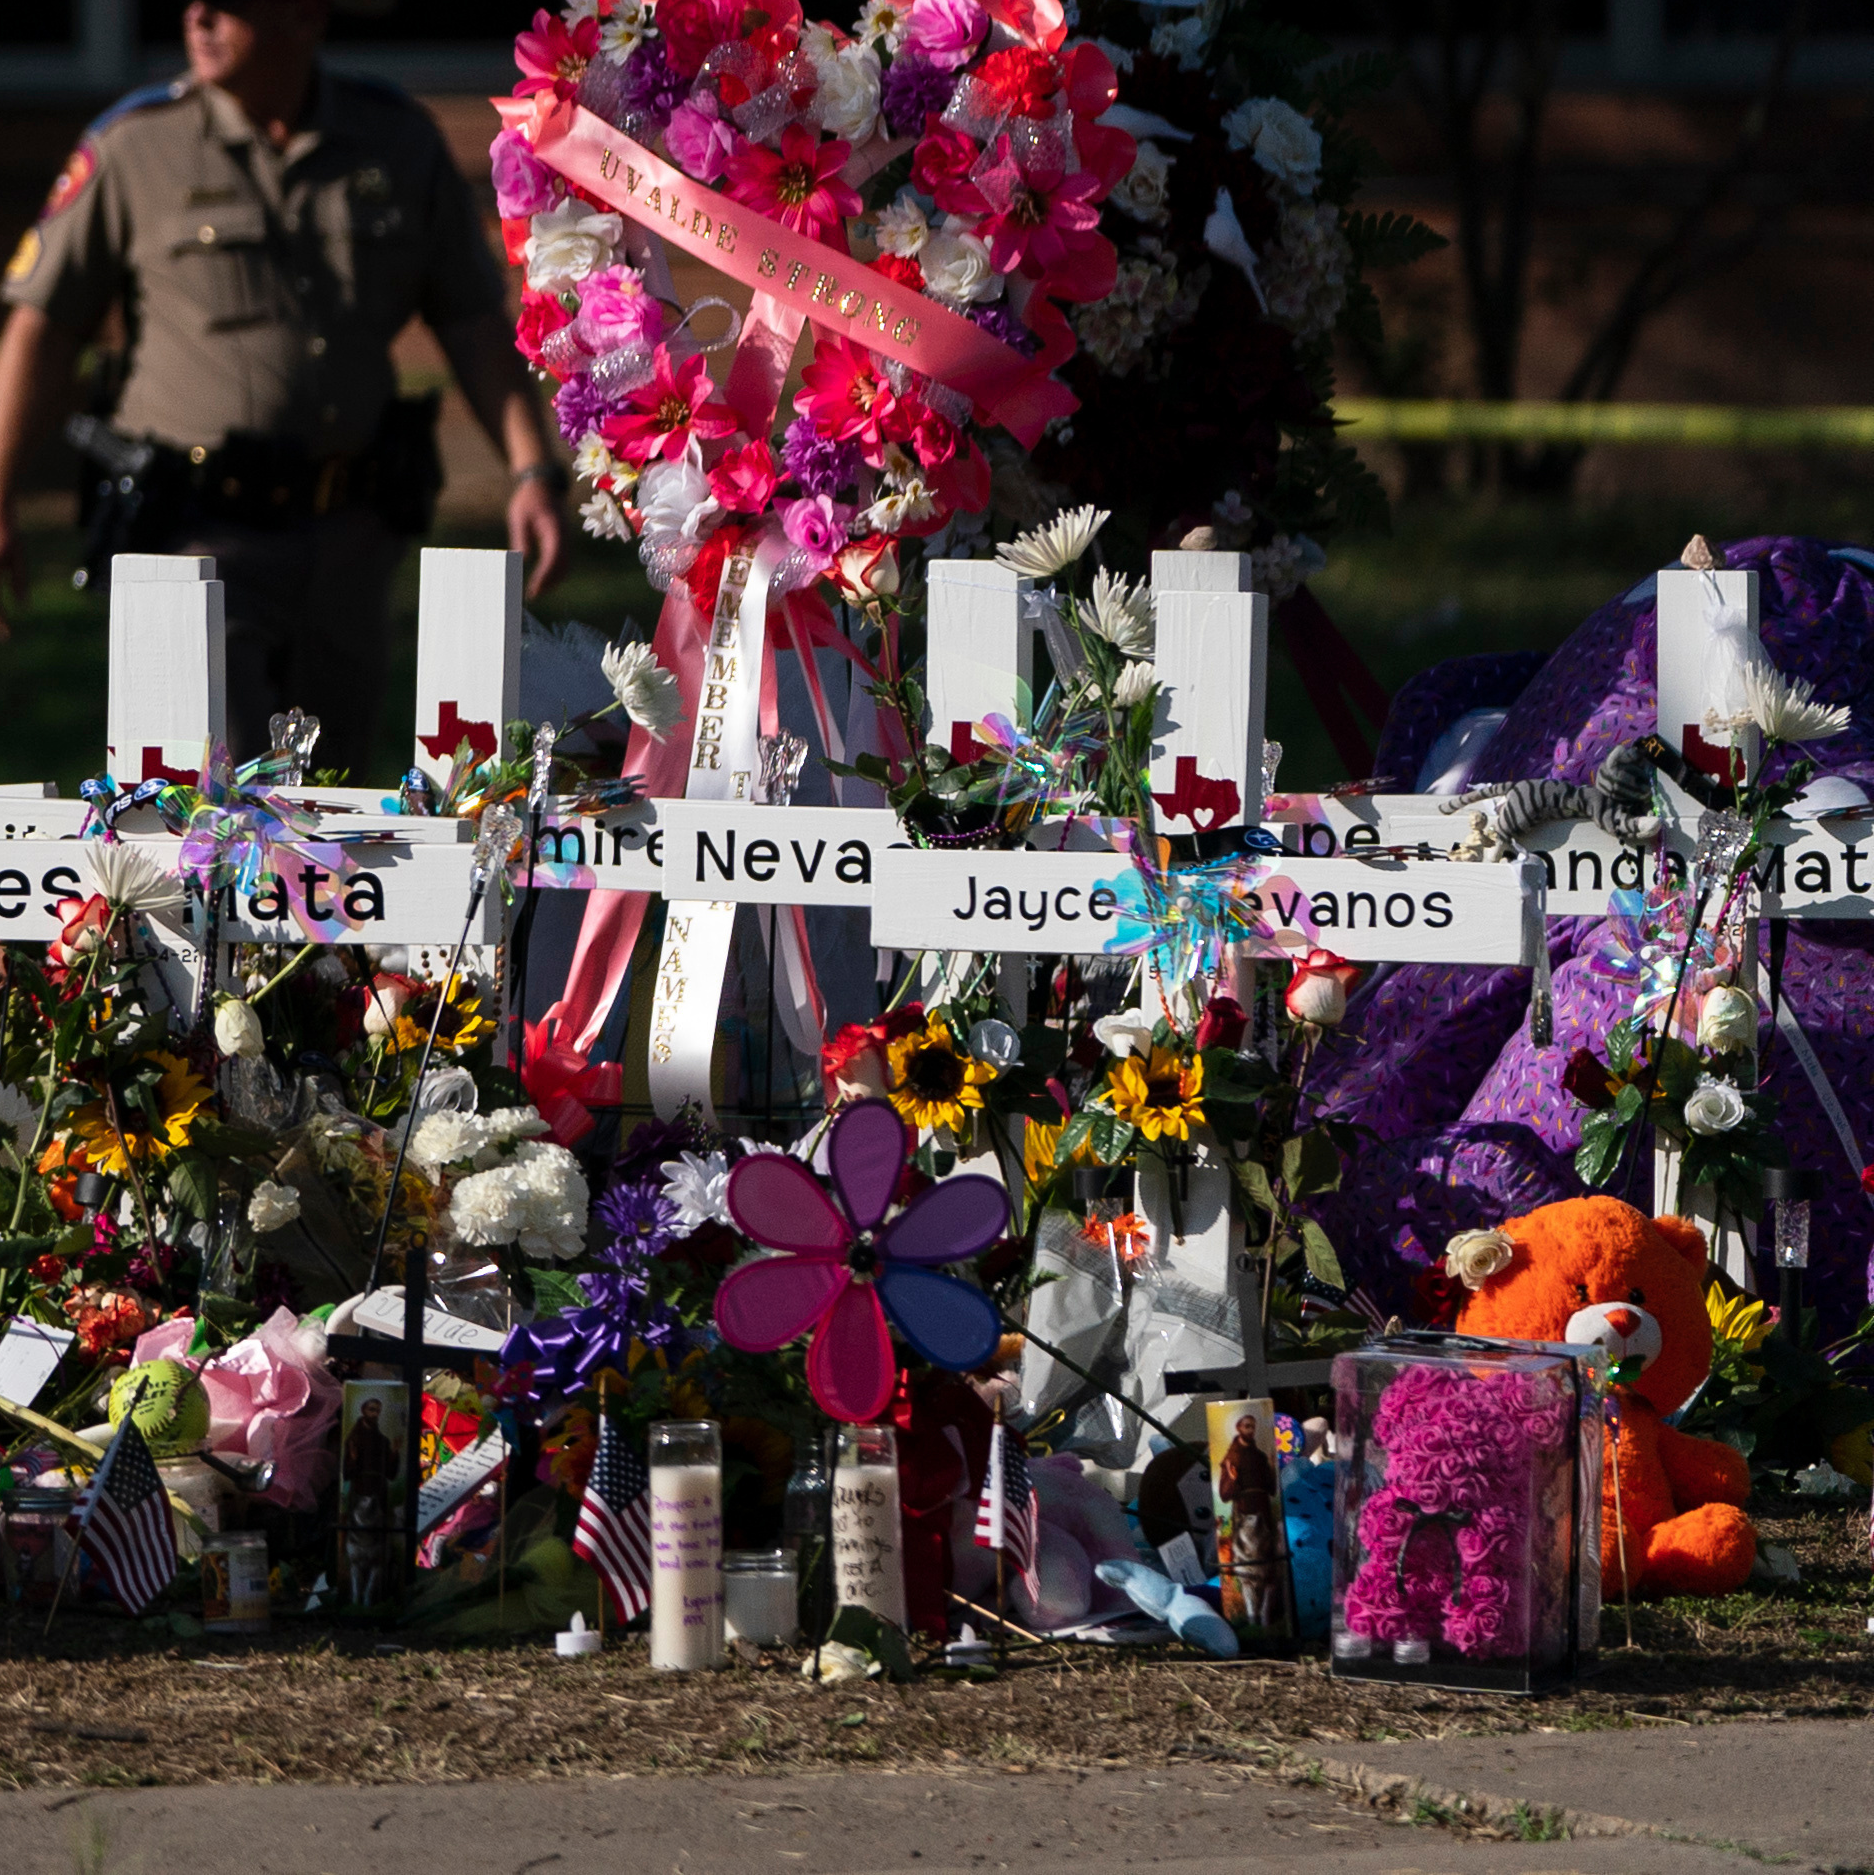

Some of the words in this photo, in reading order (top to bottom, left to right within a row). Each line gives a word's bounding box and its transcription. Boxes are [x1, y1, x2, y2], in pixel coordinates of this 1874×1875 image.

[599, 146, 740, 256] UVALDE
[756, 247, 923, 348] STRONG
[953, 875, 1118, 933] Jayce
[651, 915, 693, 1064] NAMES
